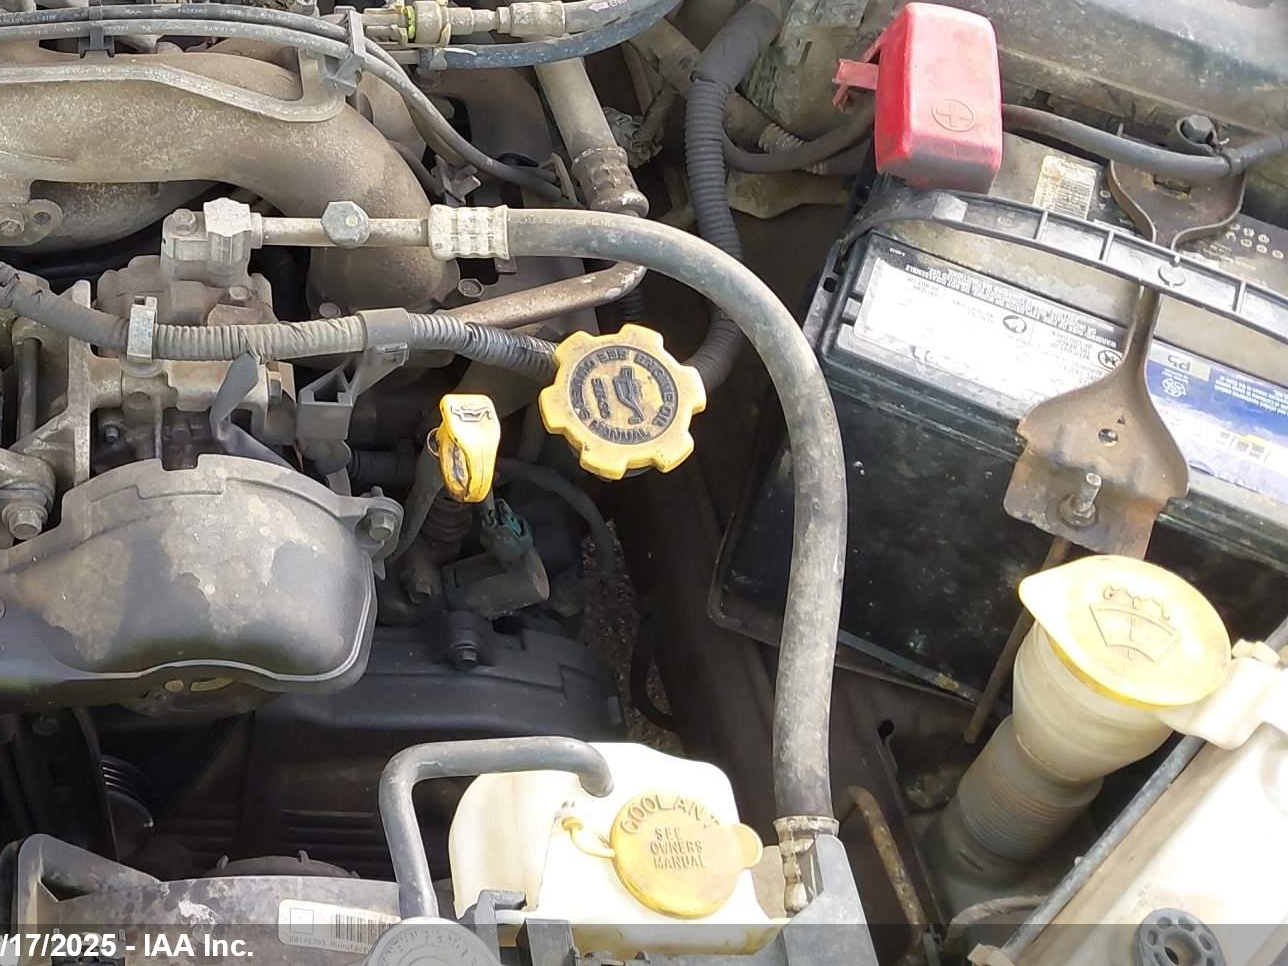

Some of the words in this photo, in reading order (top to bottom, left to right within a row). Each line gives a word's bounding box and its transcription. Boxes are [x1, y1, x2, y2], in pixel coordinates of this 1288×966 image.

[620, 794, 720, 834] COOLANT
[655, 827, 682, 841] SEE
[653, 854, 707, 870] MANUAL
